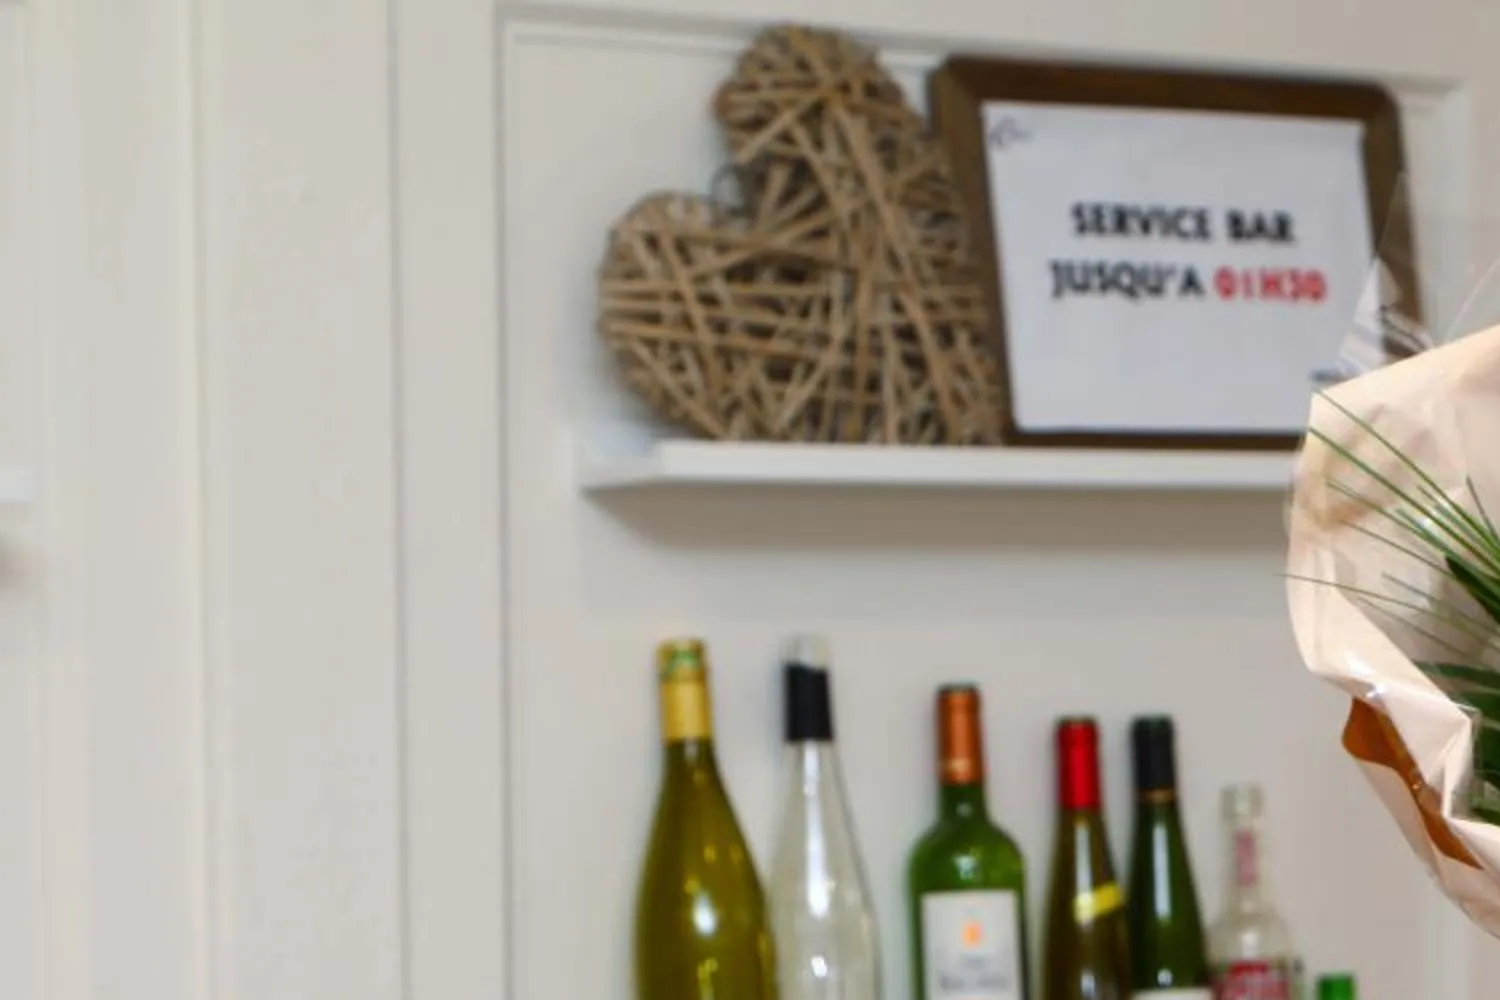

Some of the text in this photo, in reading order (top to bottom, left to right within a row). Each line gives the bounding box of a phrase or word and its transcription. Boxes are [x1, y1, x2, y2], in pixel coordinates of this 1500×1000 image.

[1070, 202, 1295, 243] SERVICE BAR
[1049, 259, 1205, 303] JUSQU'A
